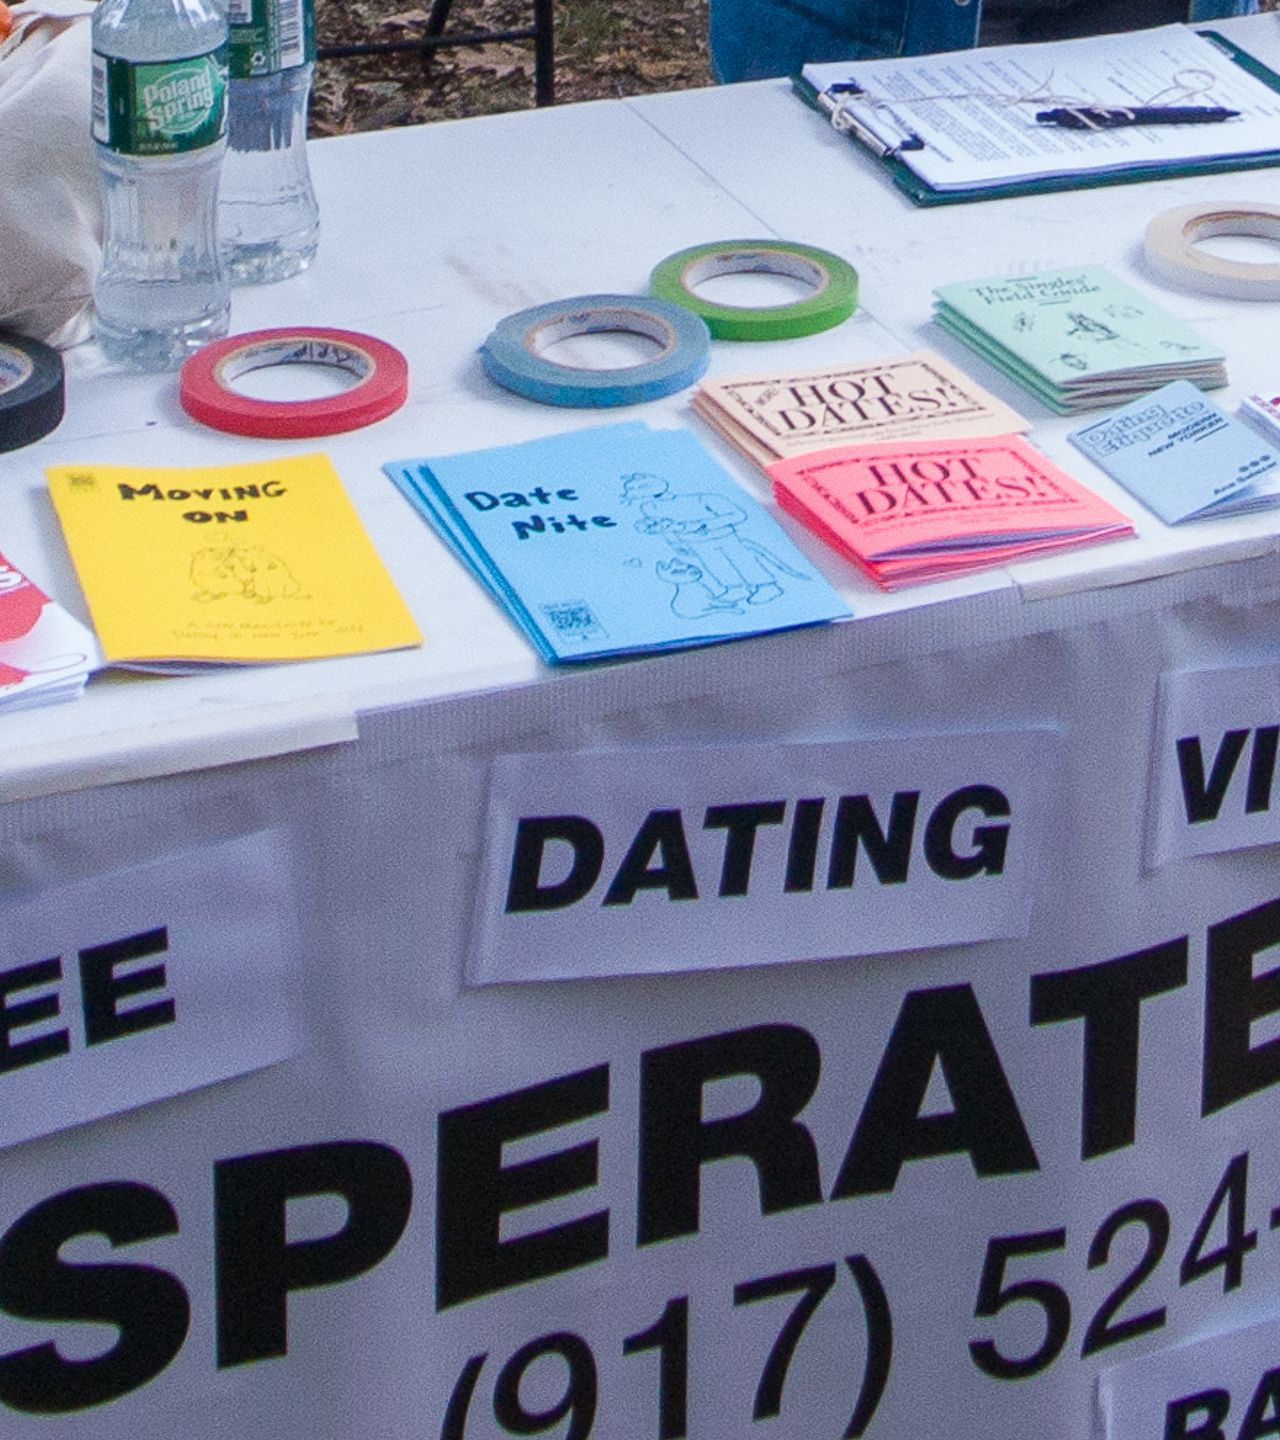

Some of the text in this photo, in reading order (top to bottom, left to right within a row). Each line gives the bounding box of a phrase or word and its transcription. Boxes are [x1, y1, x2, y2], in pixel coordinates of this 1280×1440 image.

[144, 66, 211, 108] Poland
[145, 90, 214, 132] Spring
[970, 284, 1018, 298] The
[984, 282, 1102, 306] Field Guide
[787, 373, 896, 408] HOT
[777, 386, 958, 432] DATES!
[1082, 403, 1169, 446] Dating
[1168, 413, 1218, 440] MODERN
[1148, 441, 1175, 458] NEW
[866, 457, 982, 488] HOT
[464, 486, 578, 512] Date
[854, 475, 1048, 516] DATES!
[182, 509, 249, 525] ON
[512, 512, 617, 540] Nite
[505, 785, 1010, 913] DATING
[440, 1254, 894, 1440] (917)
